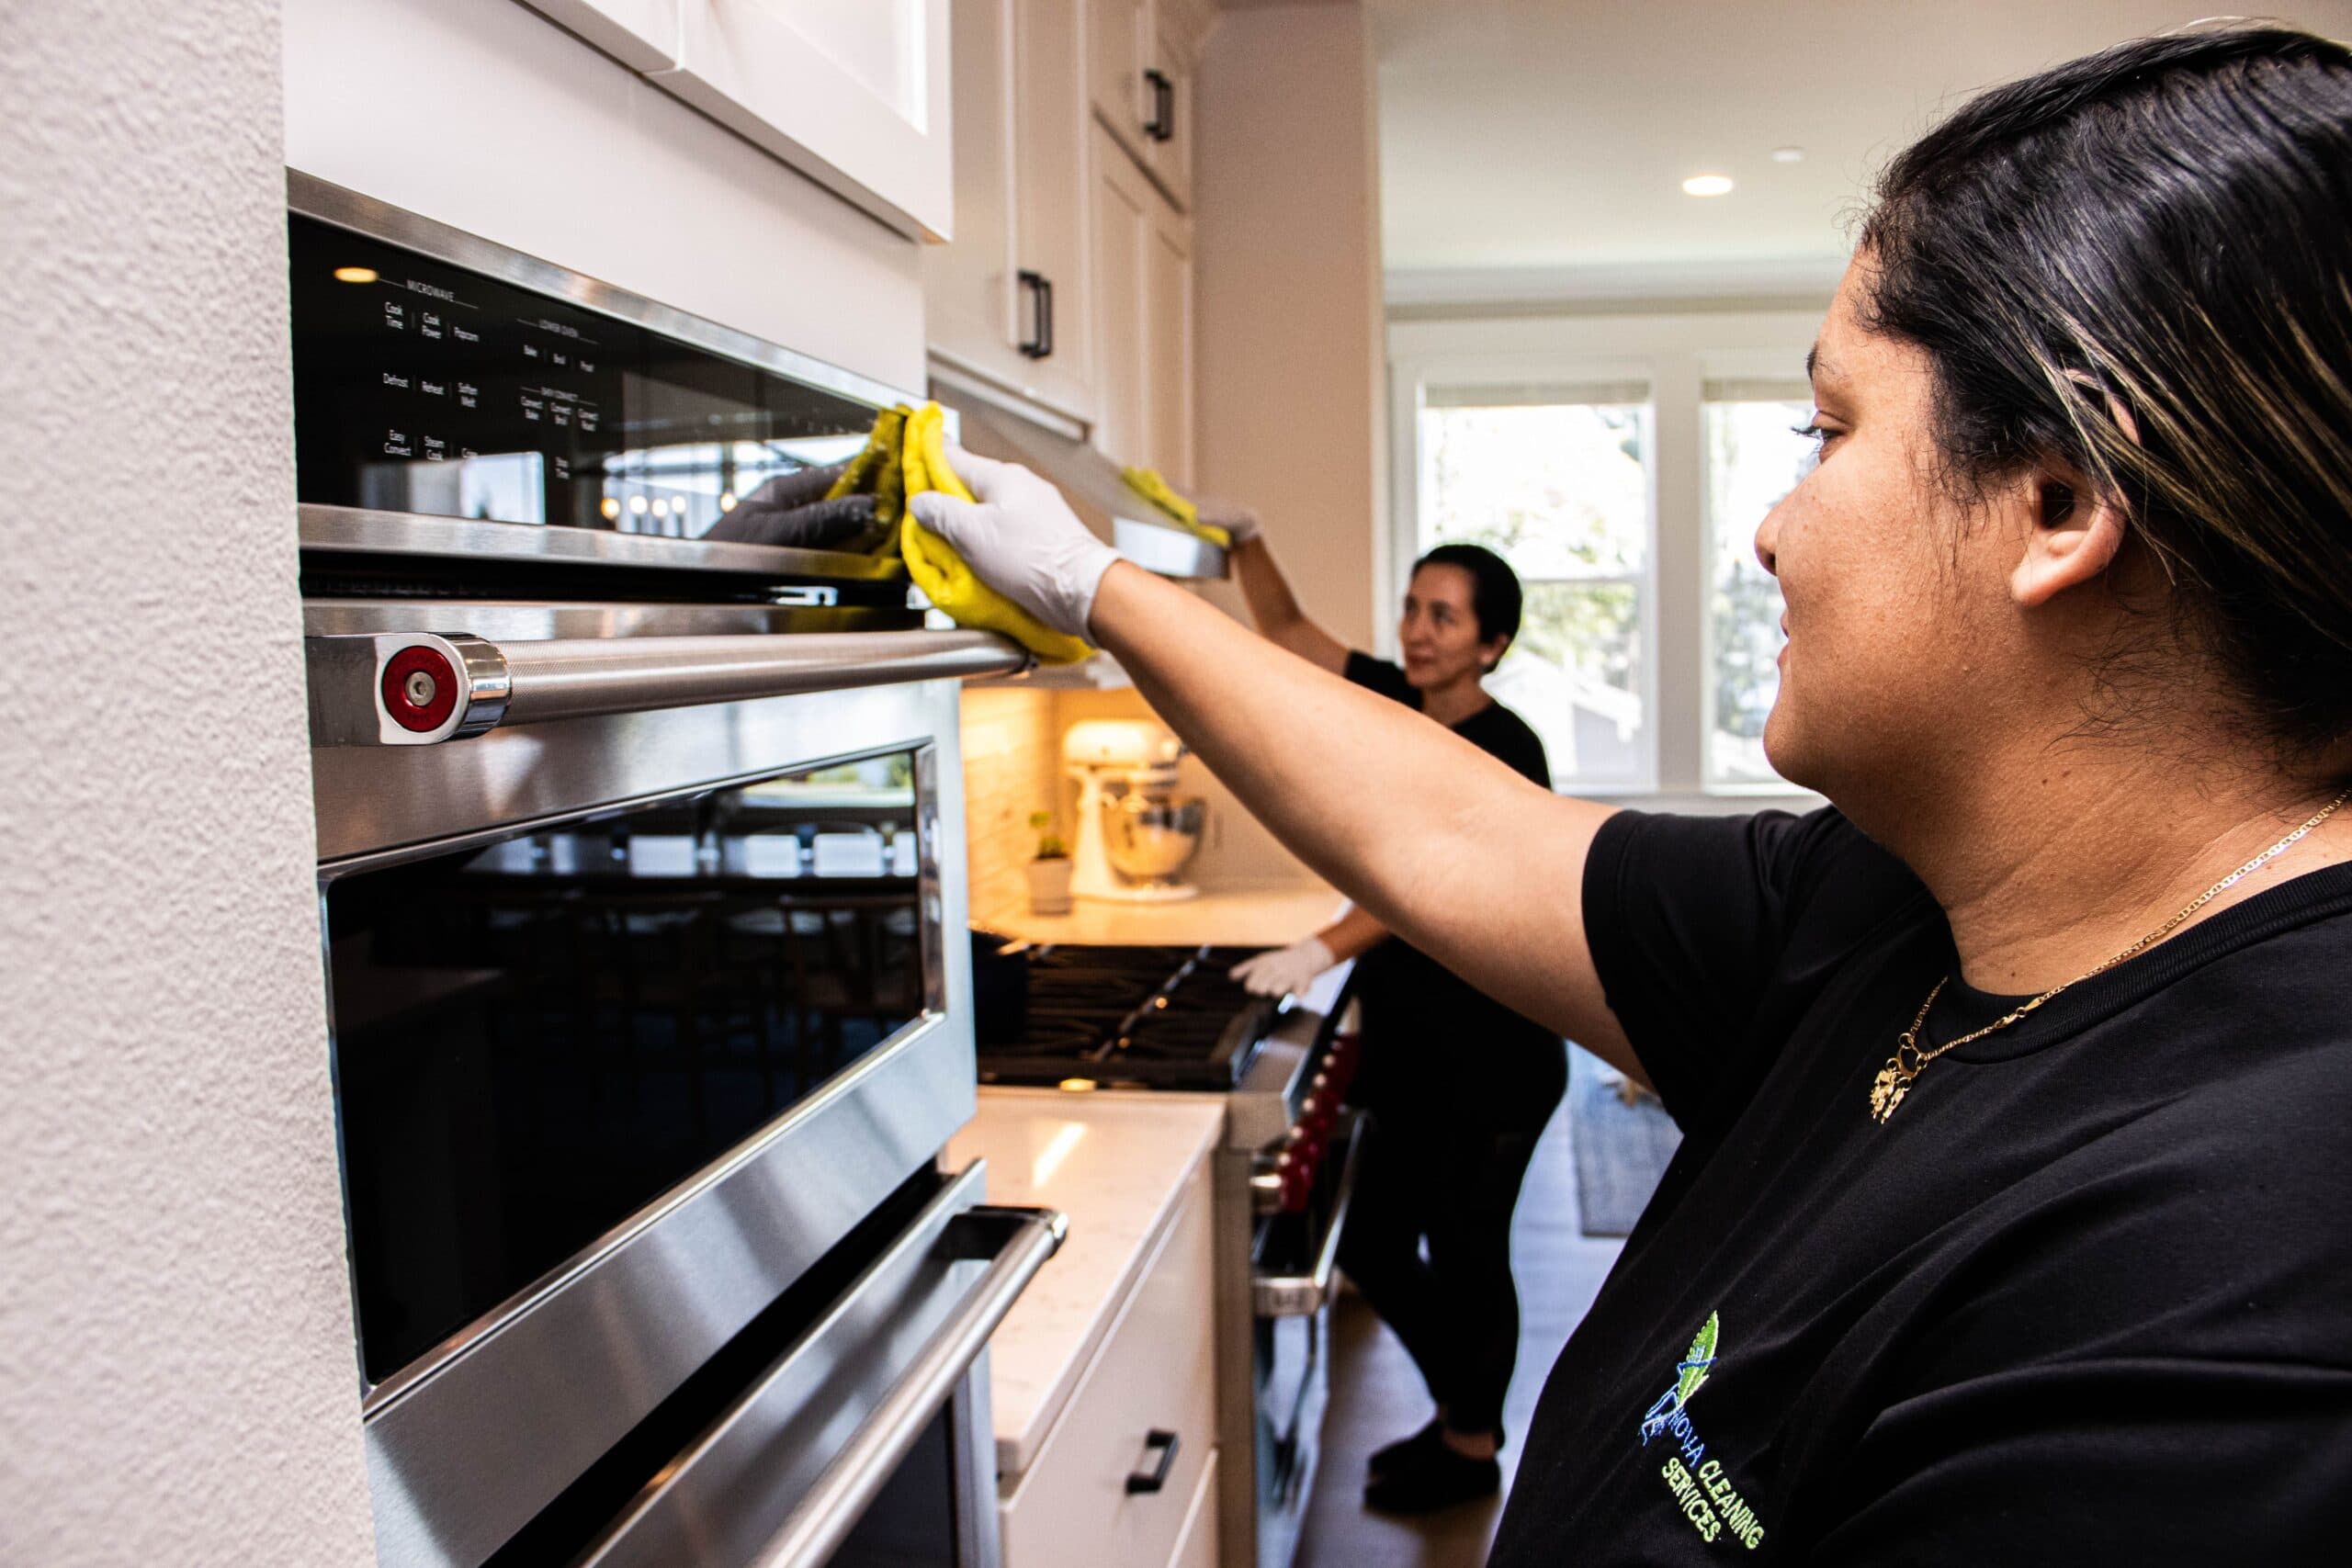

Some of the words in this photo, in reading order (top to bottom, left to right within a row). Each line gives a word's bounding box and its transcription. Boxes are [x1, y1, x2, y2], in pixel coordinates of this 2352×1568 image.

[406, 279, 455, 301] MICROWAVE
[384, 301, 403, 316] Cook
[385, 315, 404, 330] Time
[423, 312, 441, 326] Cook
[383, 373, 409, 389] Defrost
[389, 429, 405, 445] Easy
[1661, 1457, 1722, 1543] SERVICES
[1699, 1460, 1765, 1551] CLEANING
